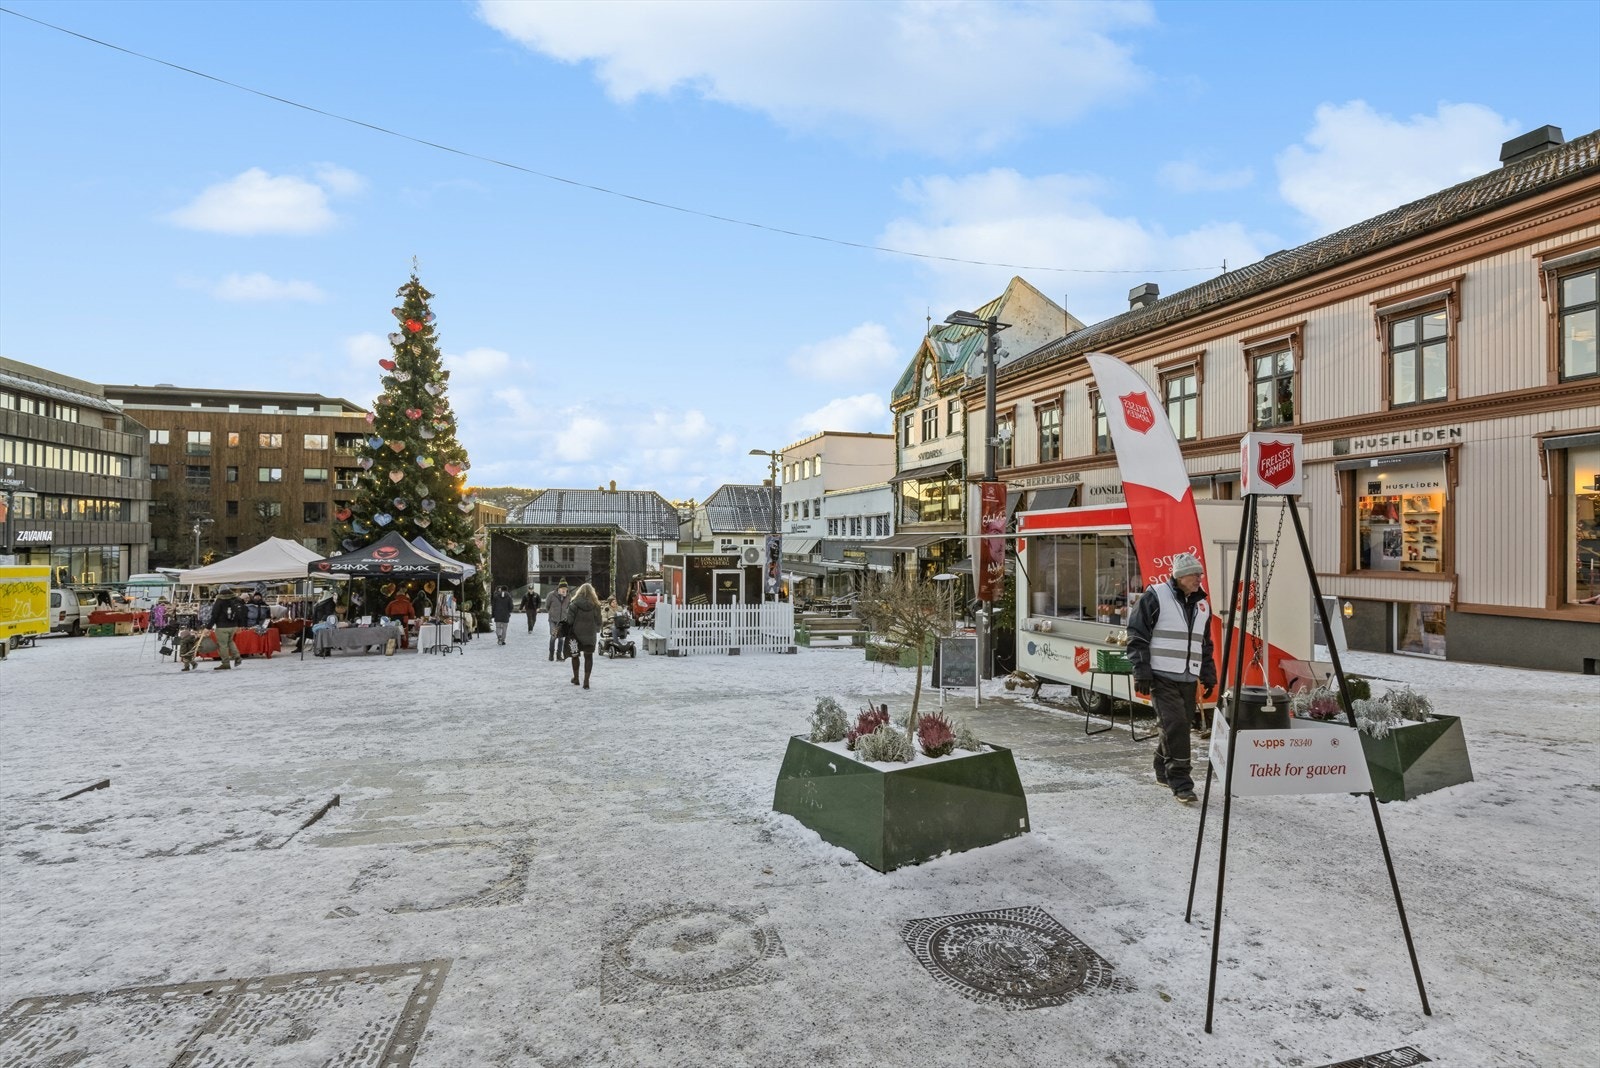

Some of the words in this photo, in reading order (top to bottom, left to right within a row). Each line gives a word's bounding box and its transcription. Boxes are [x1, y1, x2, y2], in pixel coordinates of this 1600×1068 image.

[1264, 457, 1291, 479] ARMEEN
[1026, 473, 1081, 487] HERREFRISØR
[16, 530, 53, 541] ZAVANNA
[330, 563, 370, 571] 24MX
[1253, 739, 1285, 749] vipps
[1289, 738, 1313, 747] 78340
[1250, 763, 1281, 777] Takk
[1284, 763, 1304, 776] for
[1306, 764, 1346, 779] gaven
